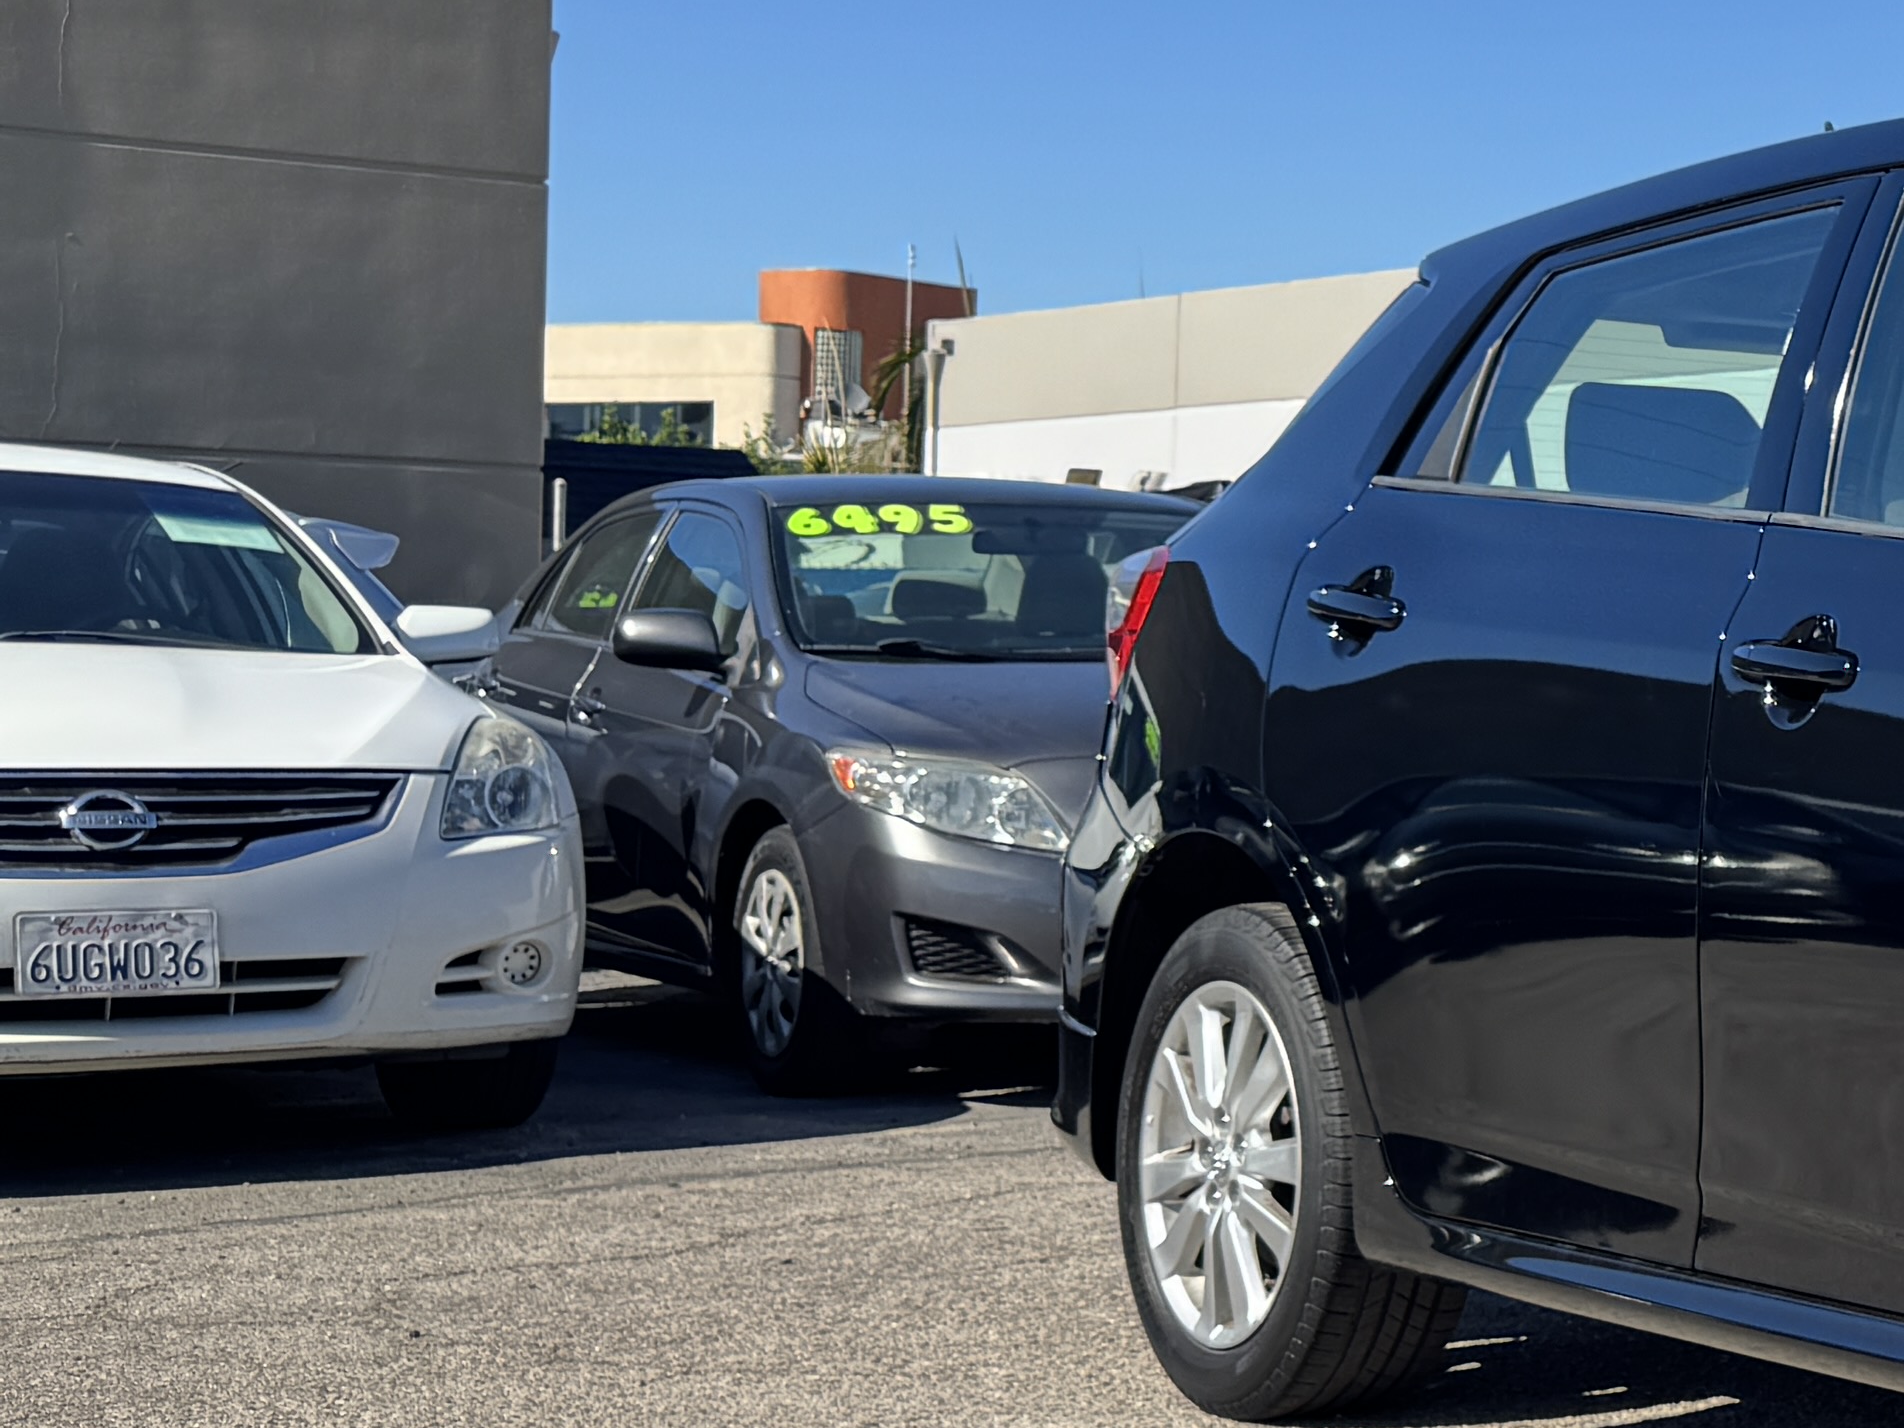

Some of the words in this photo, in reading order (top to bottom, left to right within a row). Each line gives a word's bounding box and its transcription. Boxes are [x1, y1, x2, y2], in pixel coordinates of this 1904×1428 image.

[787, 504, 972, 536] 6495
[56, 915, 181, 940] California
[28, 939, 206, 984] 6UGW036
